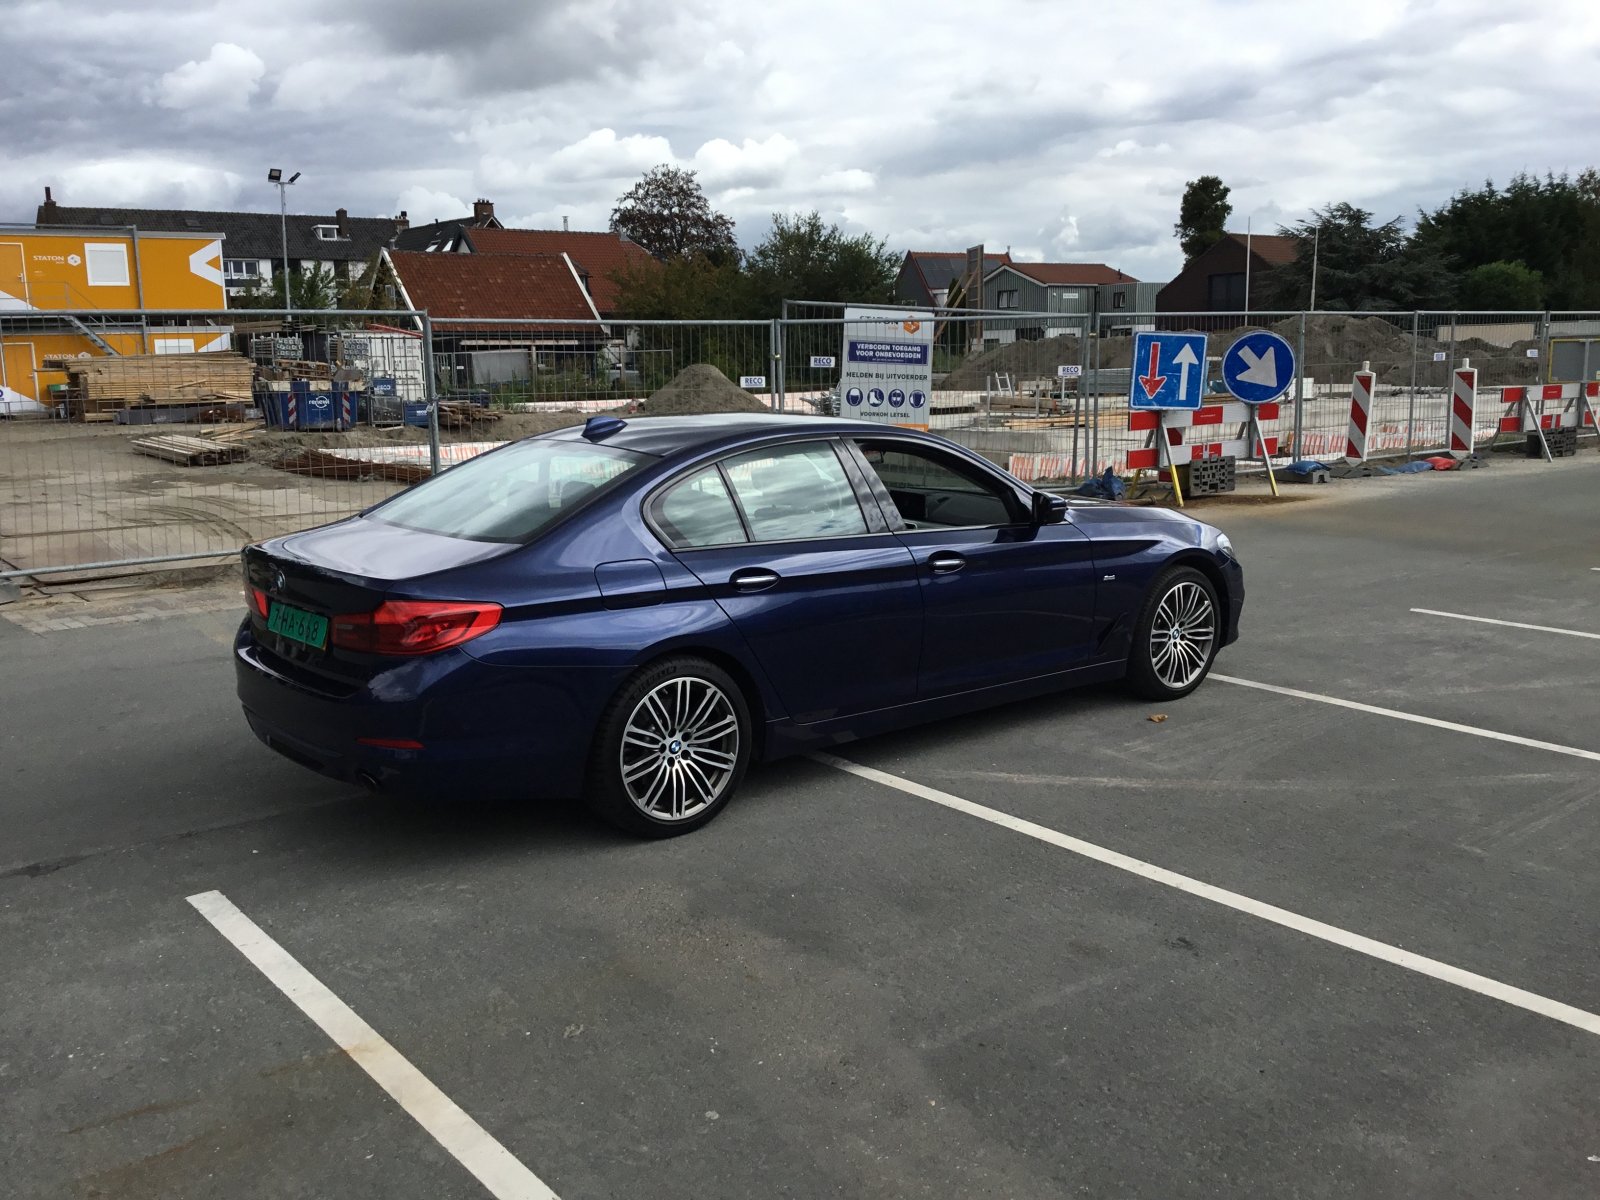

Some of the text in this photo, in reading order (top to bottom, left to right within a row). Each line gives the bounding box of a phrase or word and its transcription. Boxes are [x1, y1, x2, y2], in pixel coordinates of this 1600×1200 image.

[856, 343, 921, 352] VERBODEN TOEGANG
[874, 351, 922, 359] ONBEVOEGDEN
[846, 371, 874, 379] MELDEN
[885, 373, 928, 381] UITVOERDER
[744, 377, 763, 385] RECO
